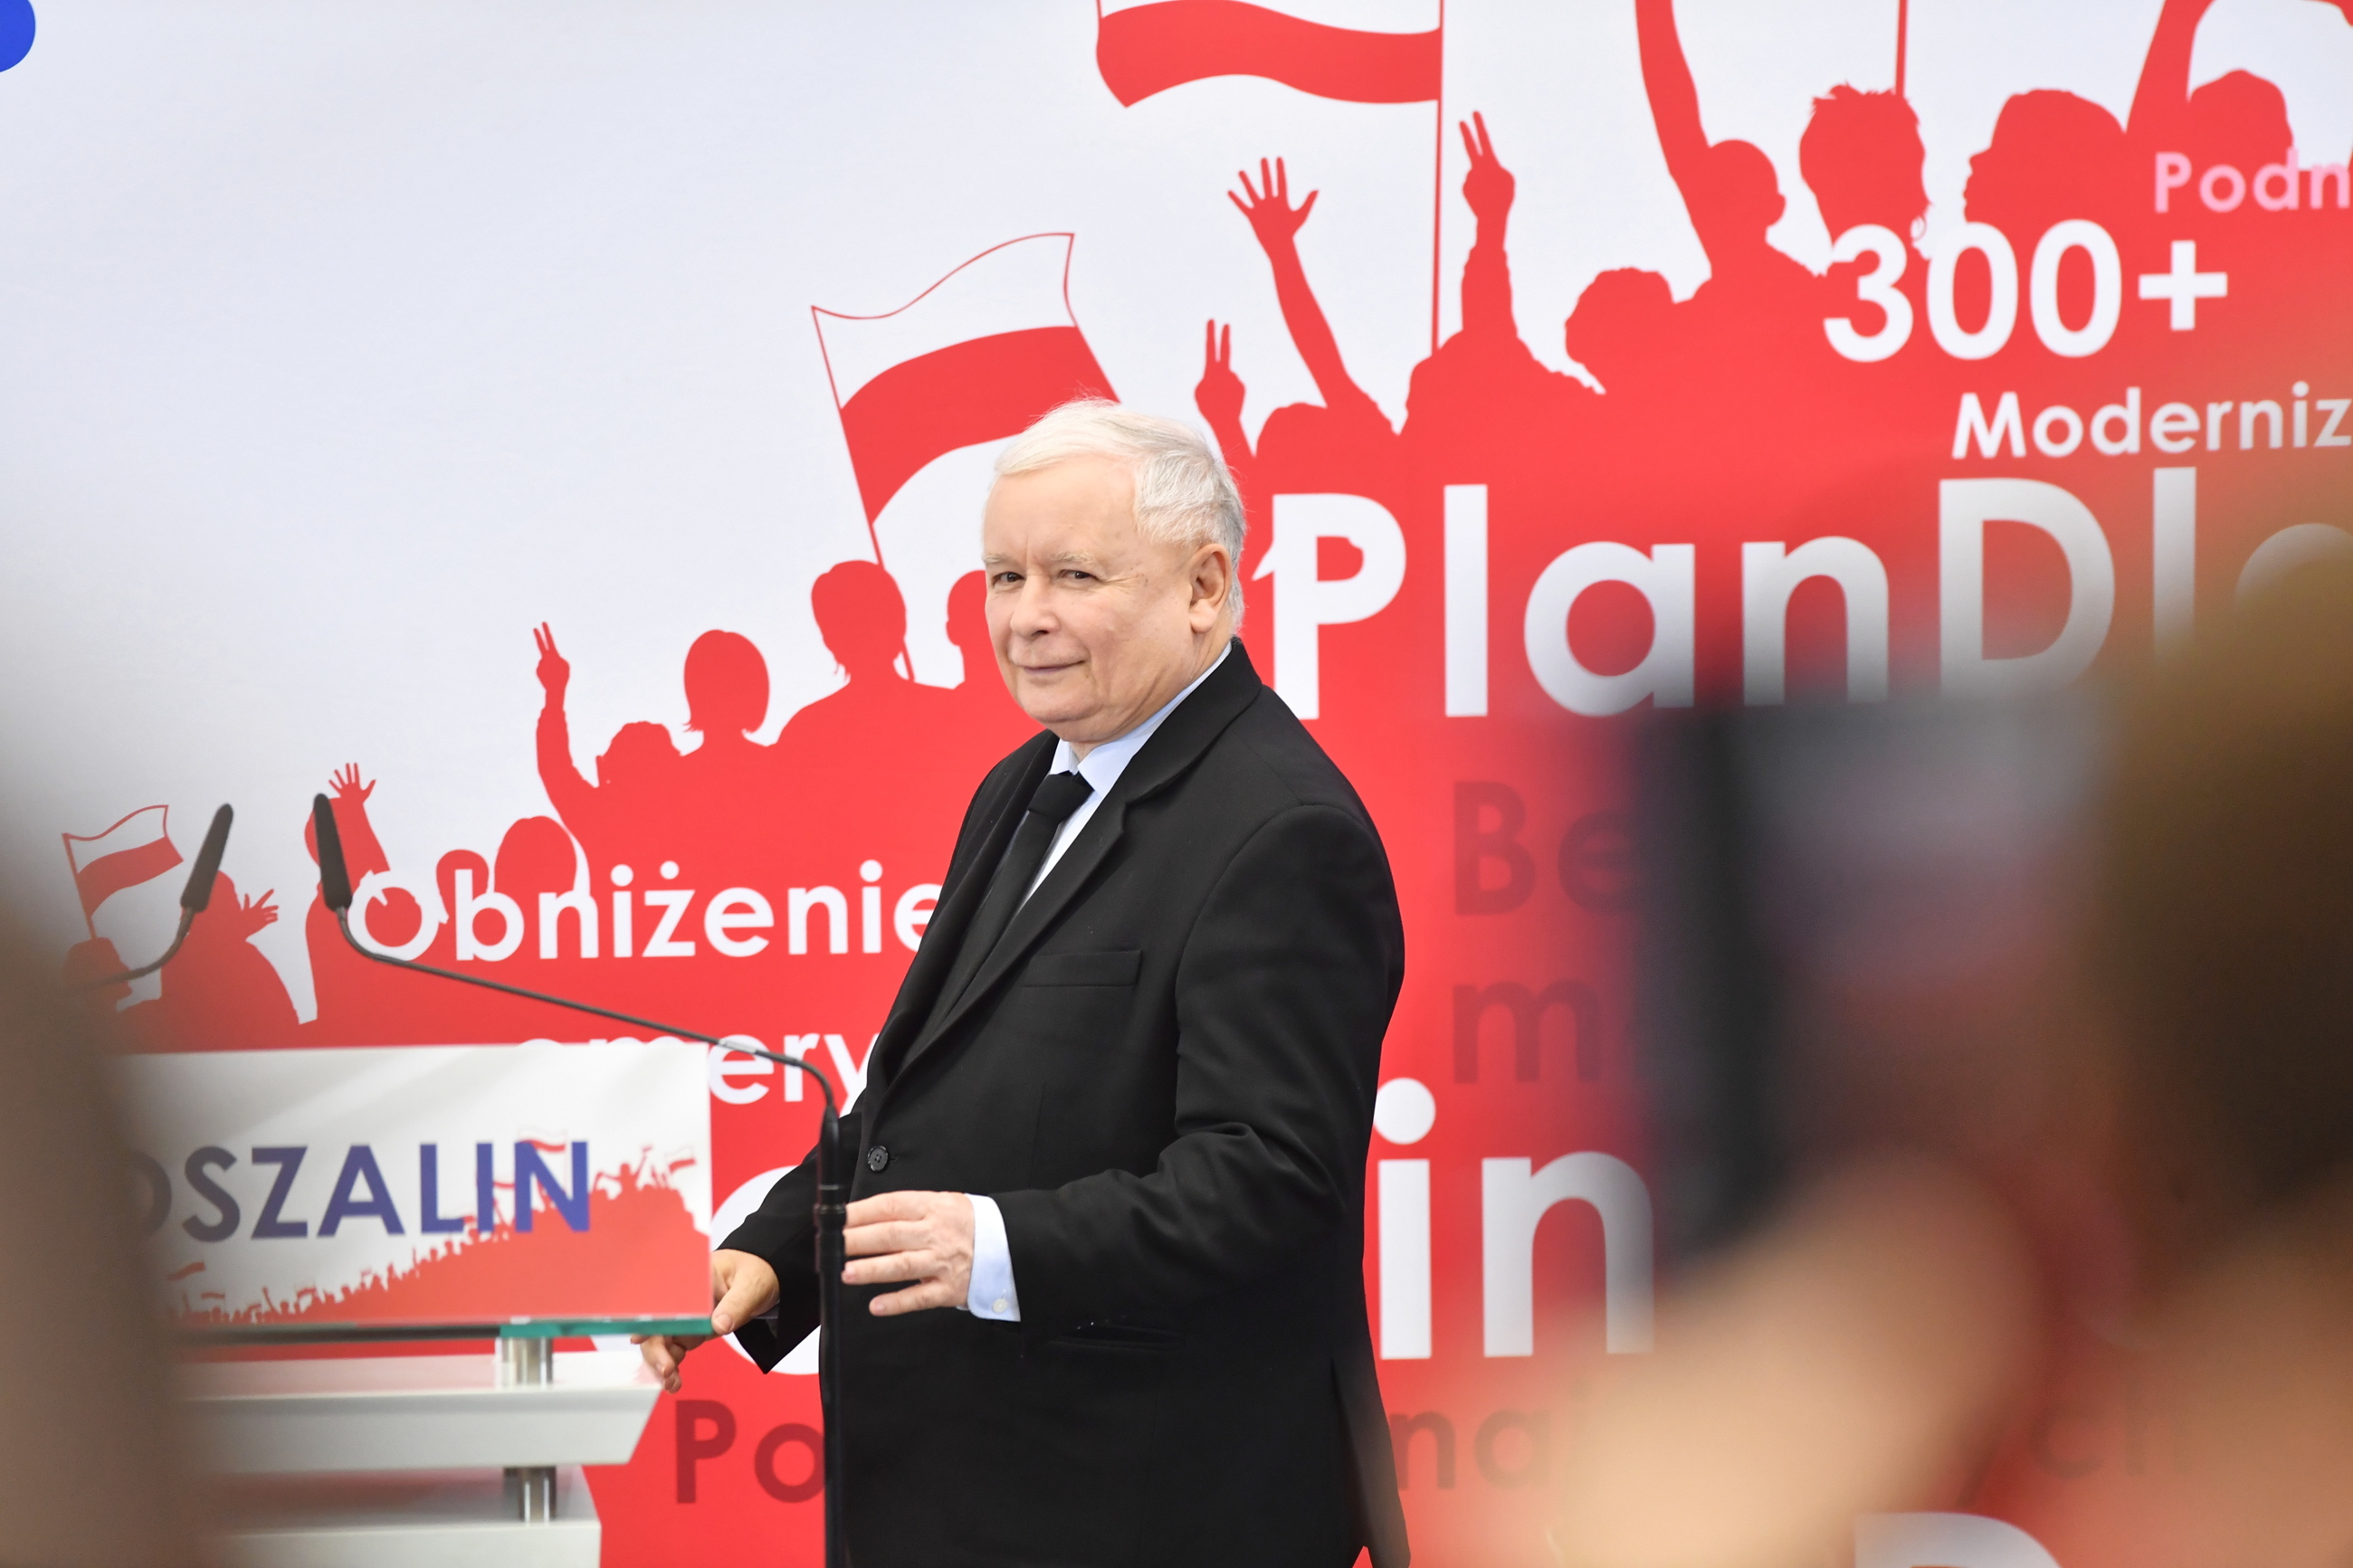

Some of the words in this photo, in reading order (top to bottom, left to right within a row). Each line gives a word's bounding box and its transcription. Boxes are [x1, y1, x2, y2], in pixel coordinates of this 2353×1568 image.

[2154, 147, 2352, 214] Podn
[1823, 219, 2228, 363] 300+
[1951, 381, 2353, 460] Moderniz
[675, 1399, 825, 1505] Po
